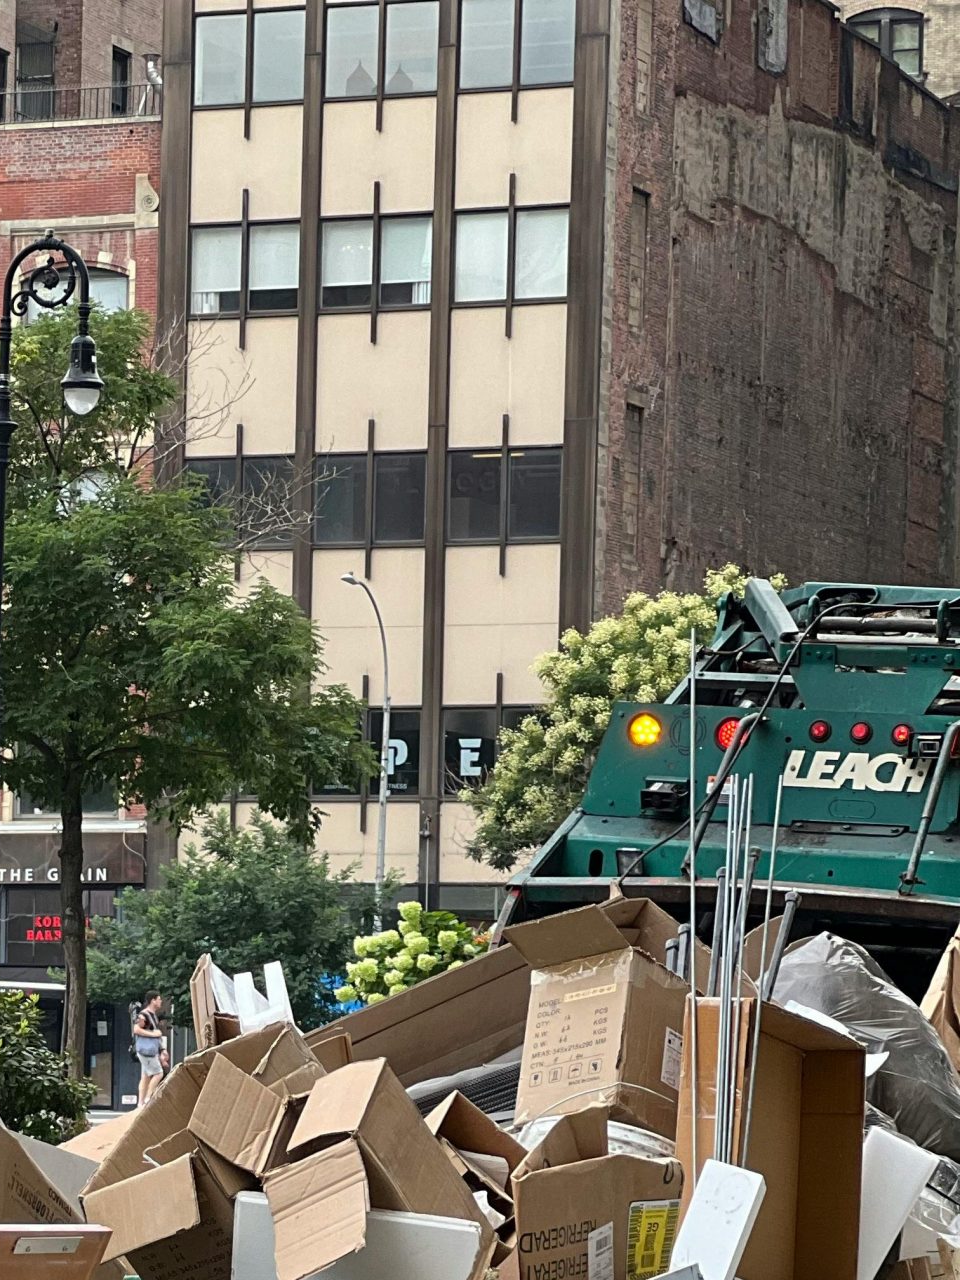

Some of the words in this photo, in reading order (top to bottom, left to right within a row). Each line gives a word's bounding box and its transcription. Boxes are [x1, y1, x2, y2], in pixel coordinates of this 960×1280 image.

[458, 738, 482, 776] E
[782, 749, 931, 793] LEACH
[47, 868, 107, 882] GIN
[520, 1218, 597, 1253] REFRIGERAD
[646, 1222, 659, 1233] GE
